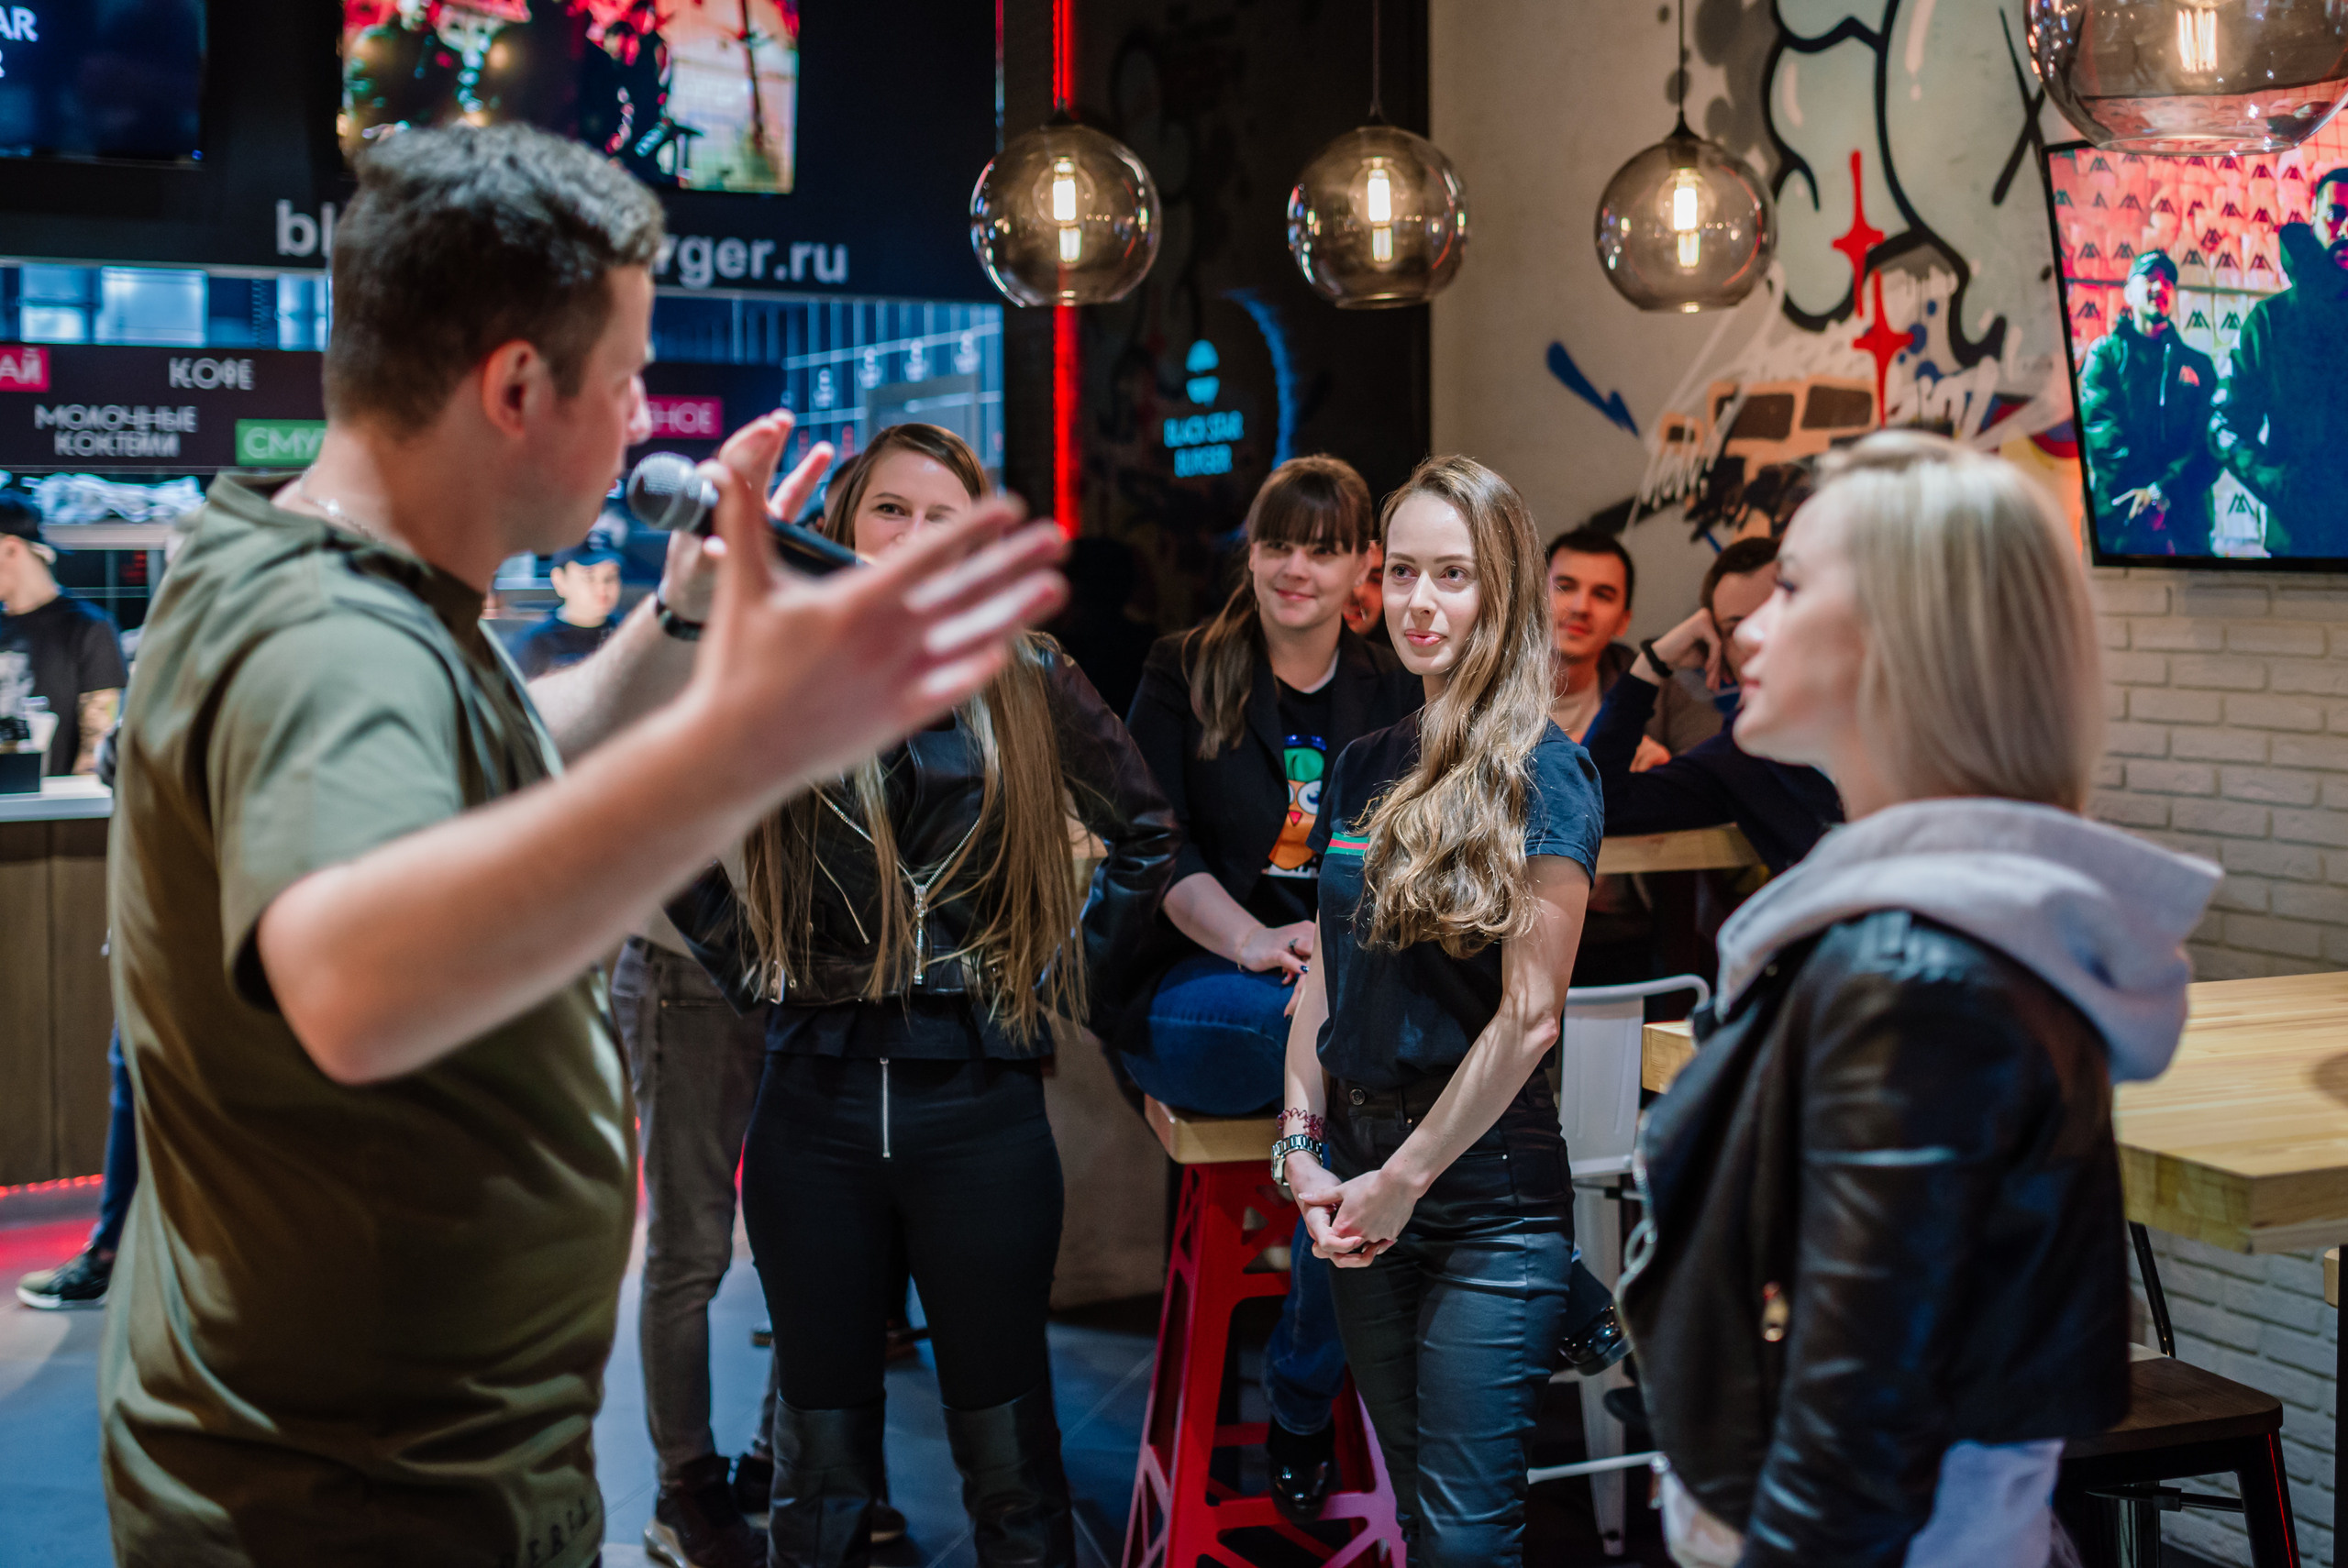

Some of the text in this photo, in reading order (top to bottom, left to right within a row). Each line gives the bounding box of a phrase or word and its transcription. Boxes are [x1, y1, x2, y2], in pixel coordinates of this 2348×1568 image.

[169, 357, 256, 391] КОФЕ
[34, 403, 199, 434] МОЛОЧНЫЕ
[54, 428, 181, 458] КОКТЕЙЛИ
